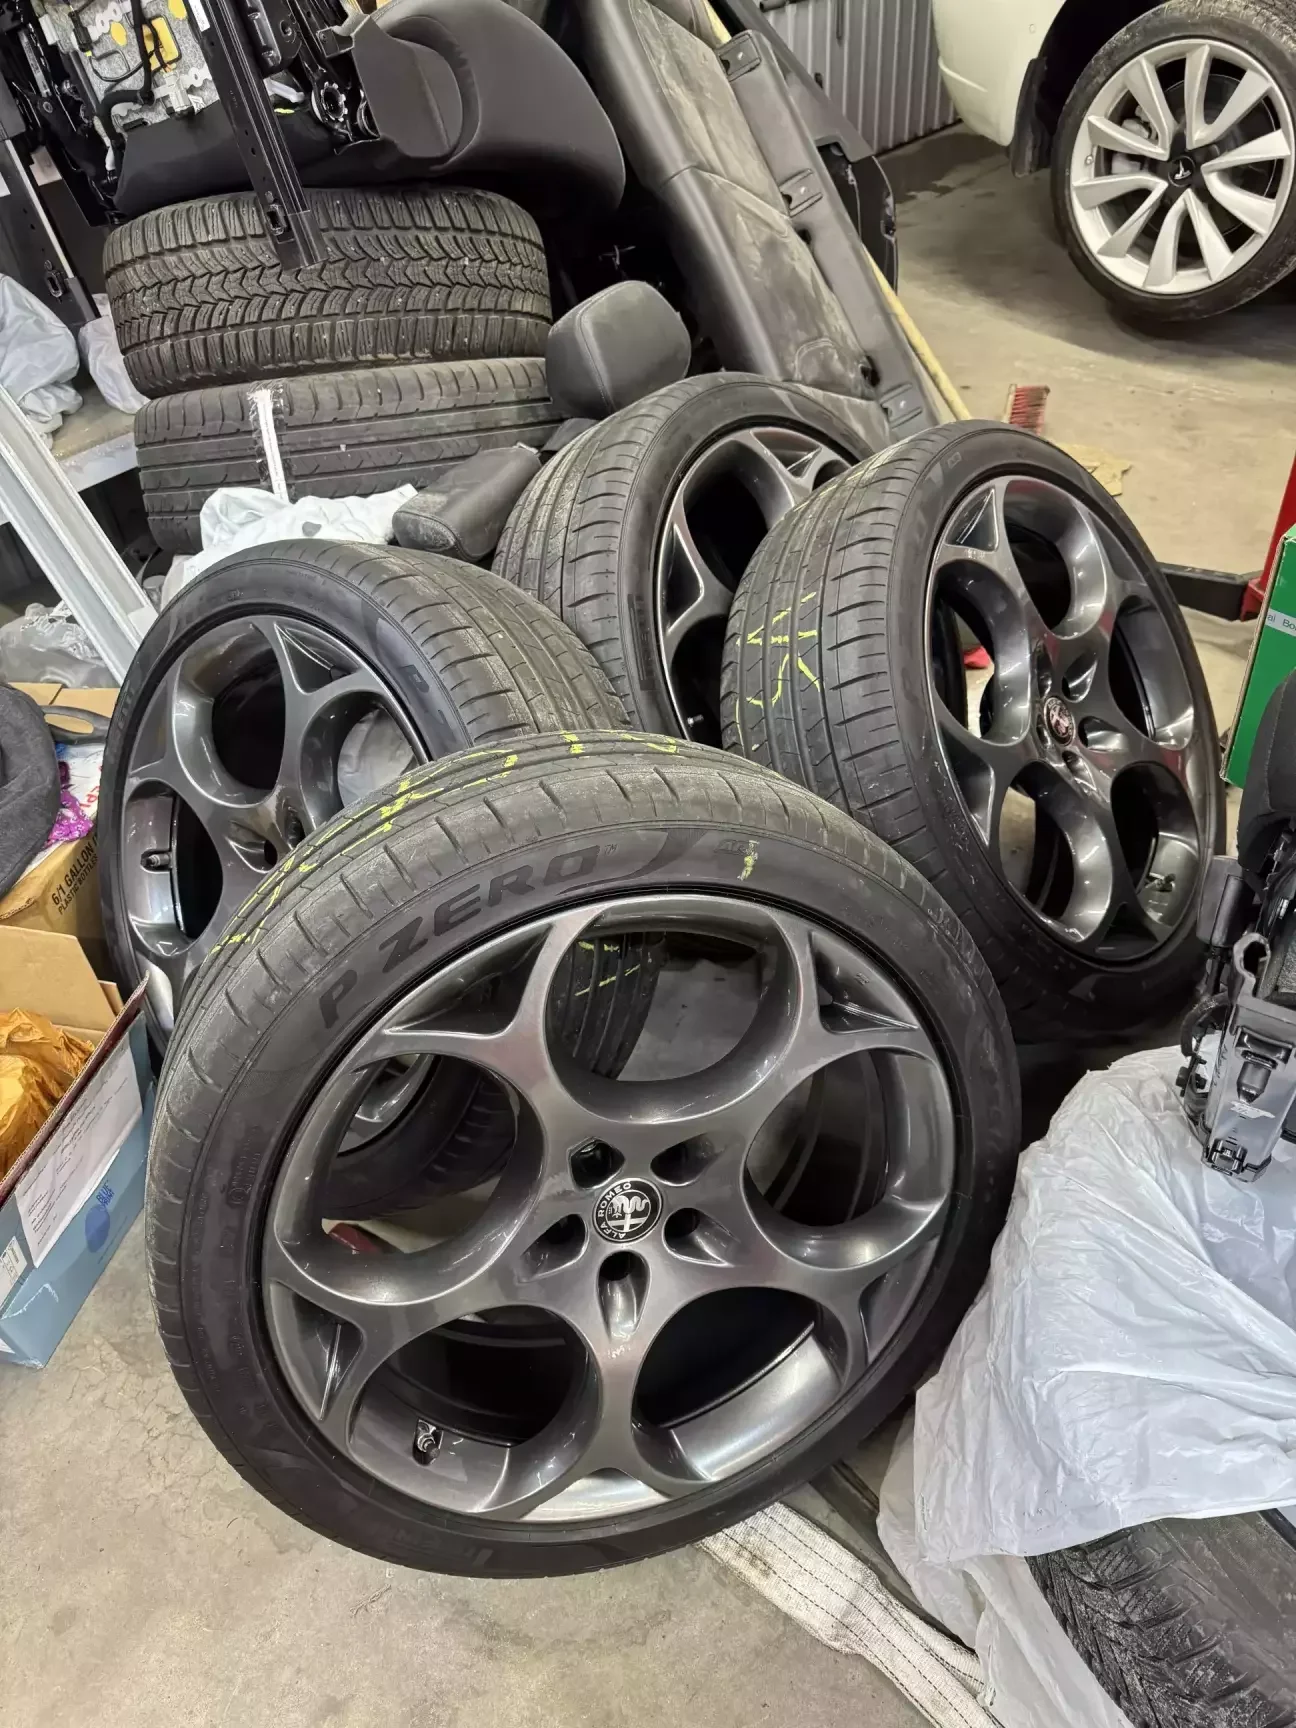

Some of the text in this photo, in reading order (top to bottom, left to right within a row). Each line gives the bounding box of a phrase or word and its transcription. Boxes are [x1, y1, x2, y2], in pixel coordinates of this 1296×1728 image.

[51, 844, 94, 906] 6/1 GALLON
[58, 882, 79, 915] PLASTIC
[318, 969, 358, 1029] P
[379, 845, 600, 974] ZERO
[597, 1182, 632, 1239] ALFA ROMEO
